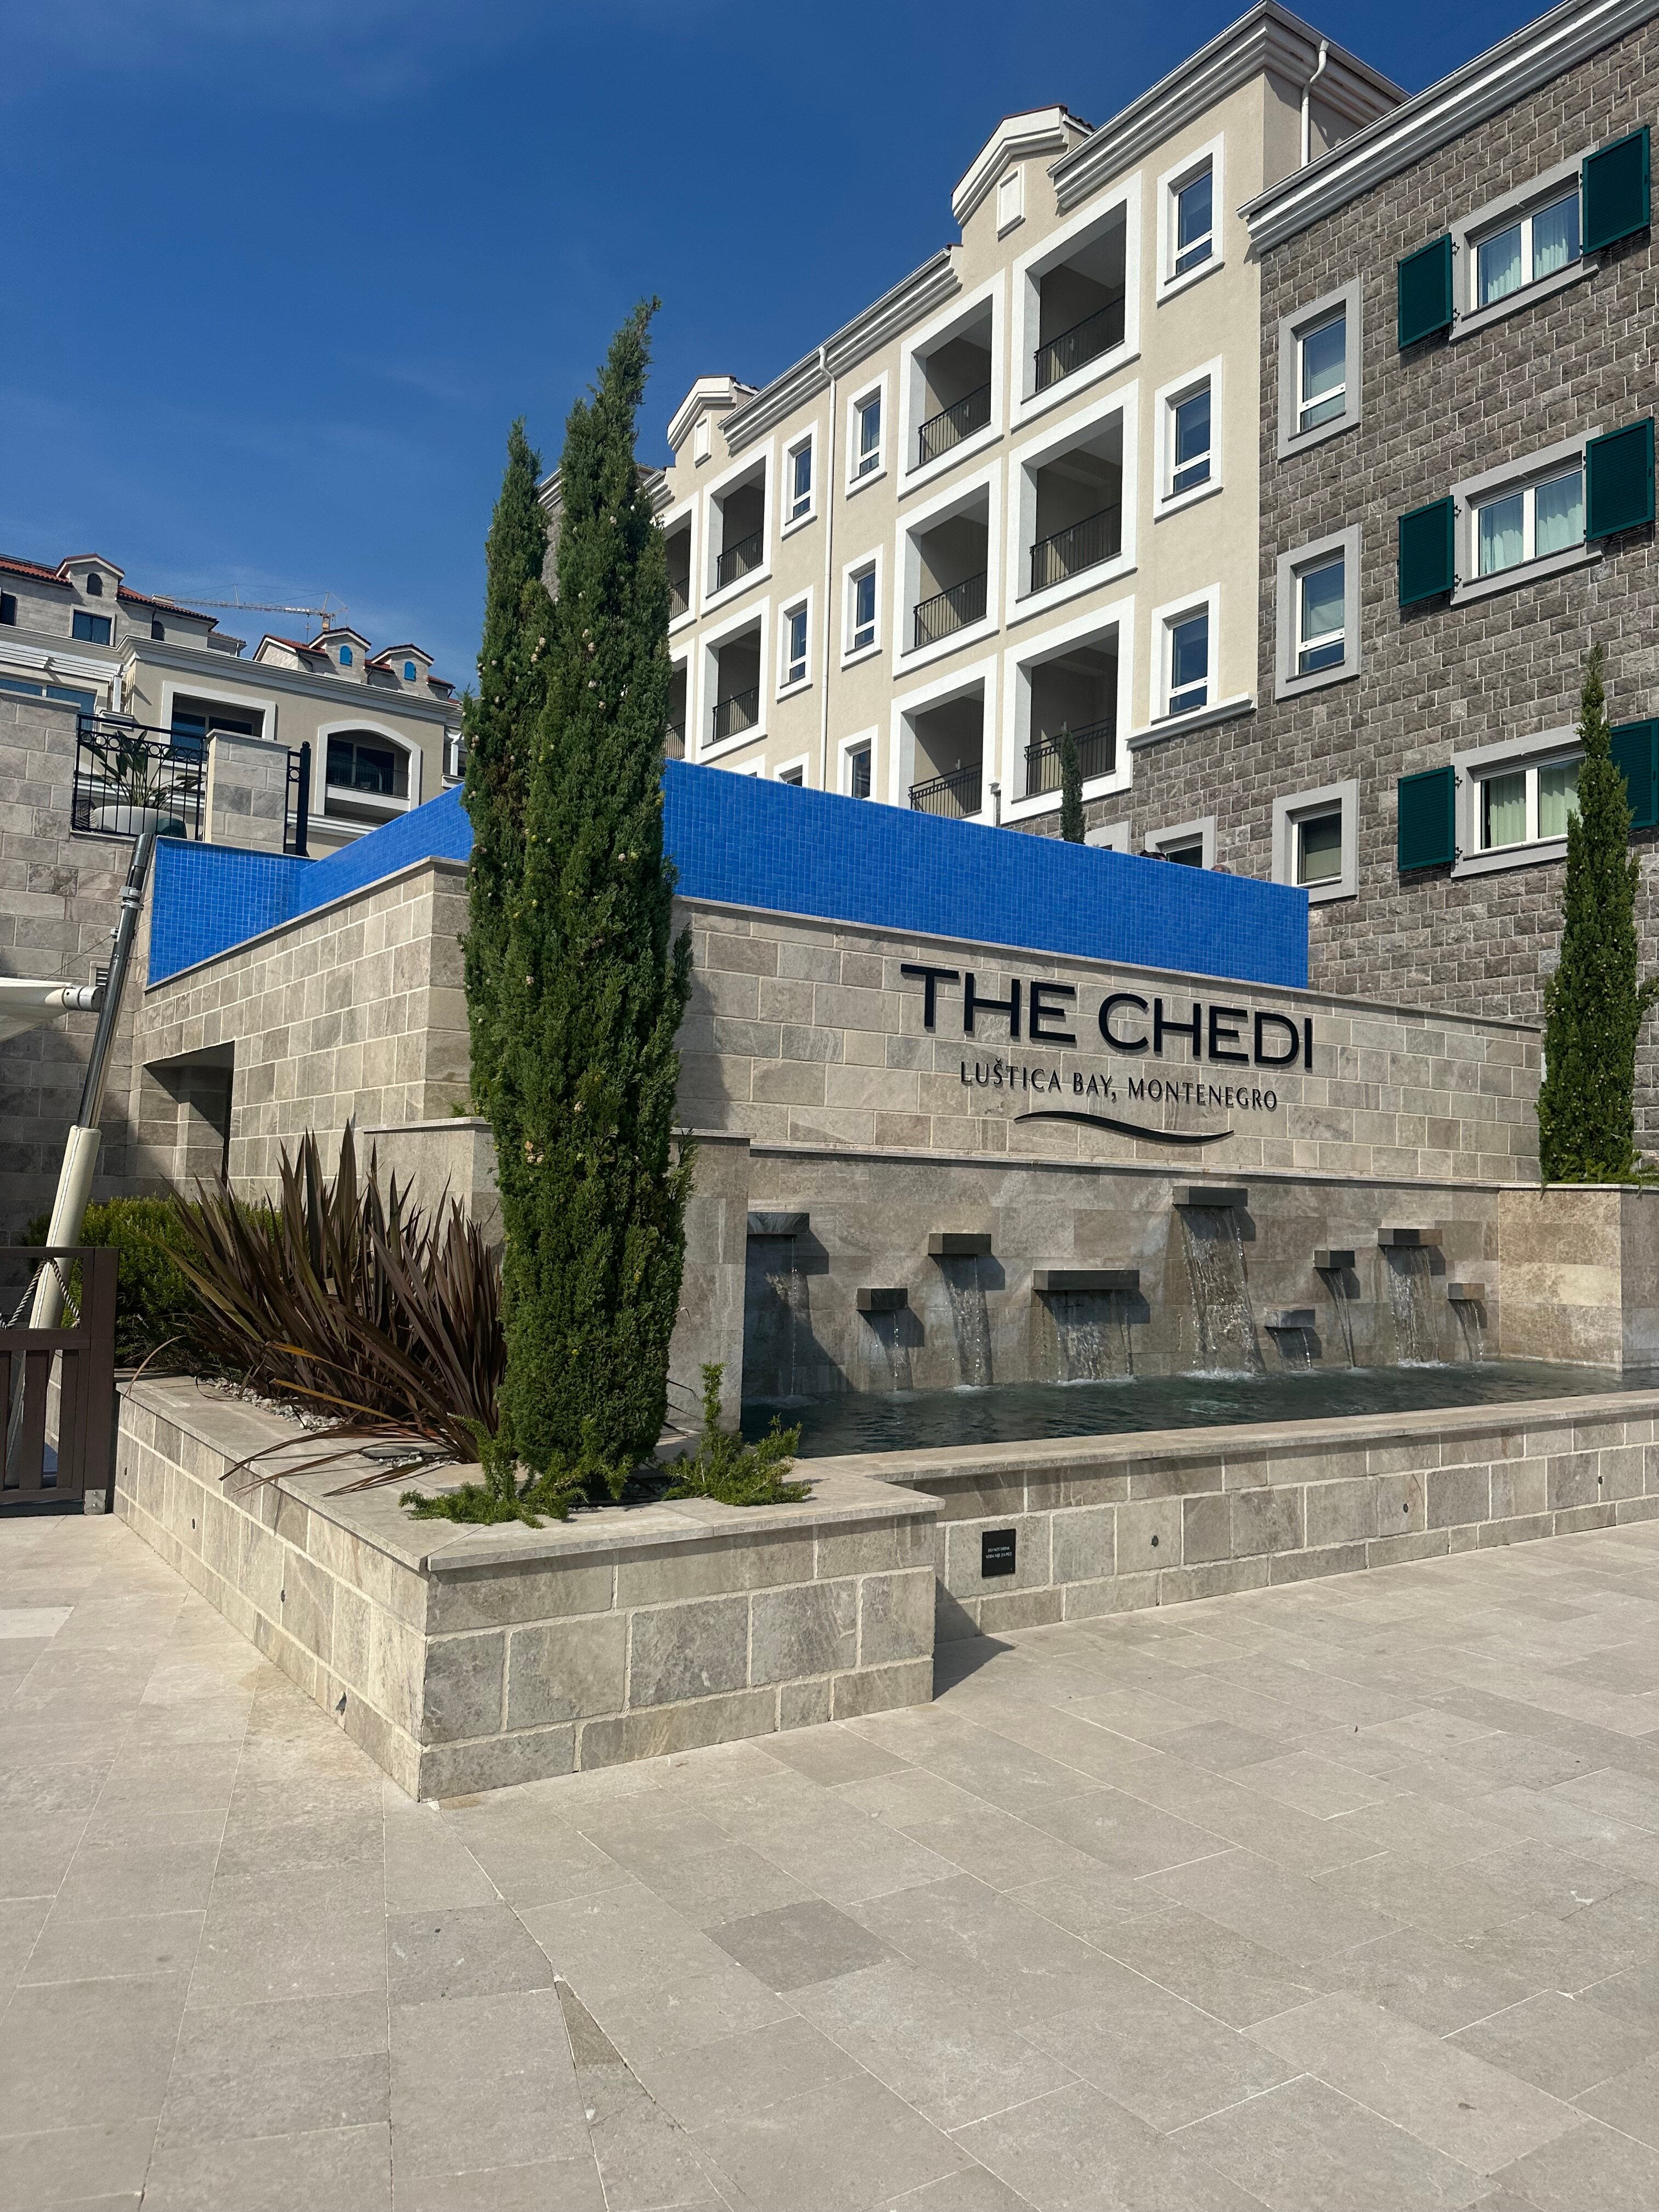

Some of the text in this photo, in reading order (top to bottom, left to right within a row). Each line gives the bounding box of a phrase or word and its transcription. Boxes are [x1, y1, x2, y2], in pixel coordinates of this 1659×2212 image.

[900, 963, 1312, 1069] THE CHEDI
[961, 1058, 1277, 1109] LUŠTICA BAY, MONTENEGRO
